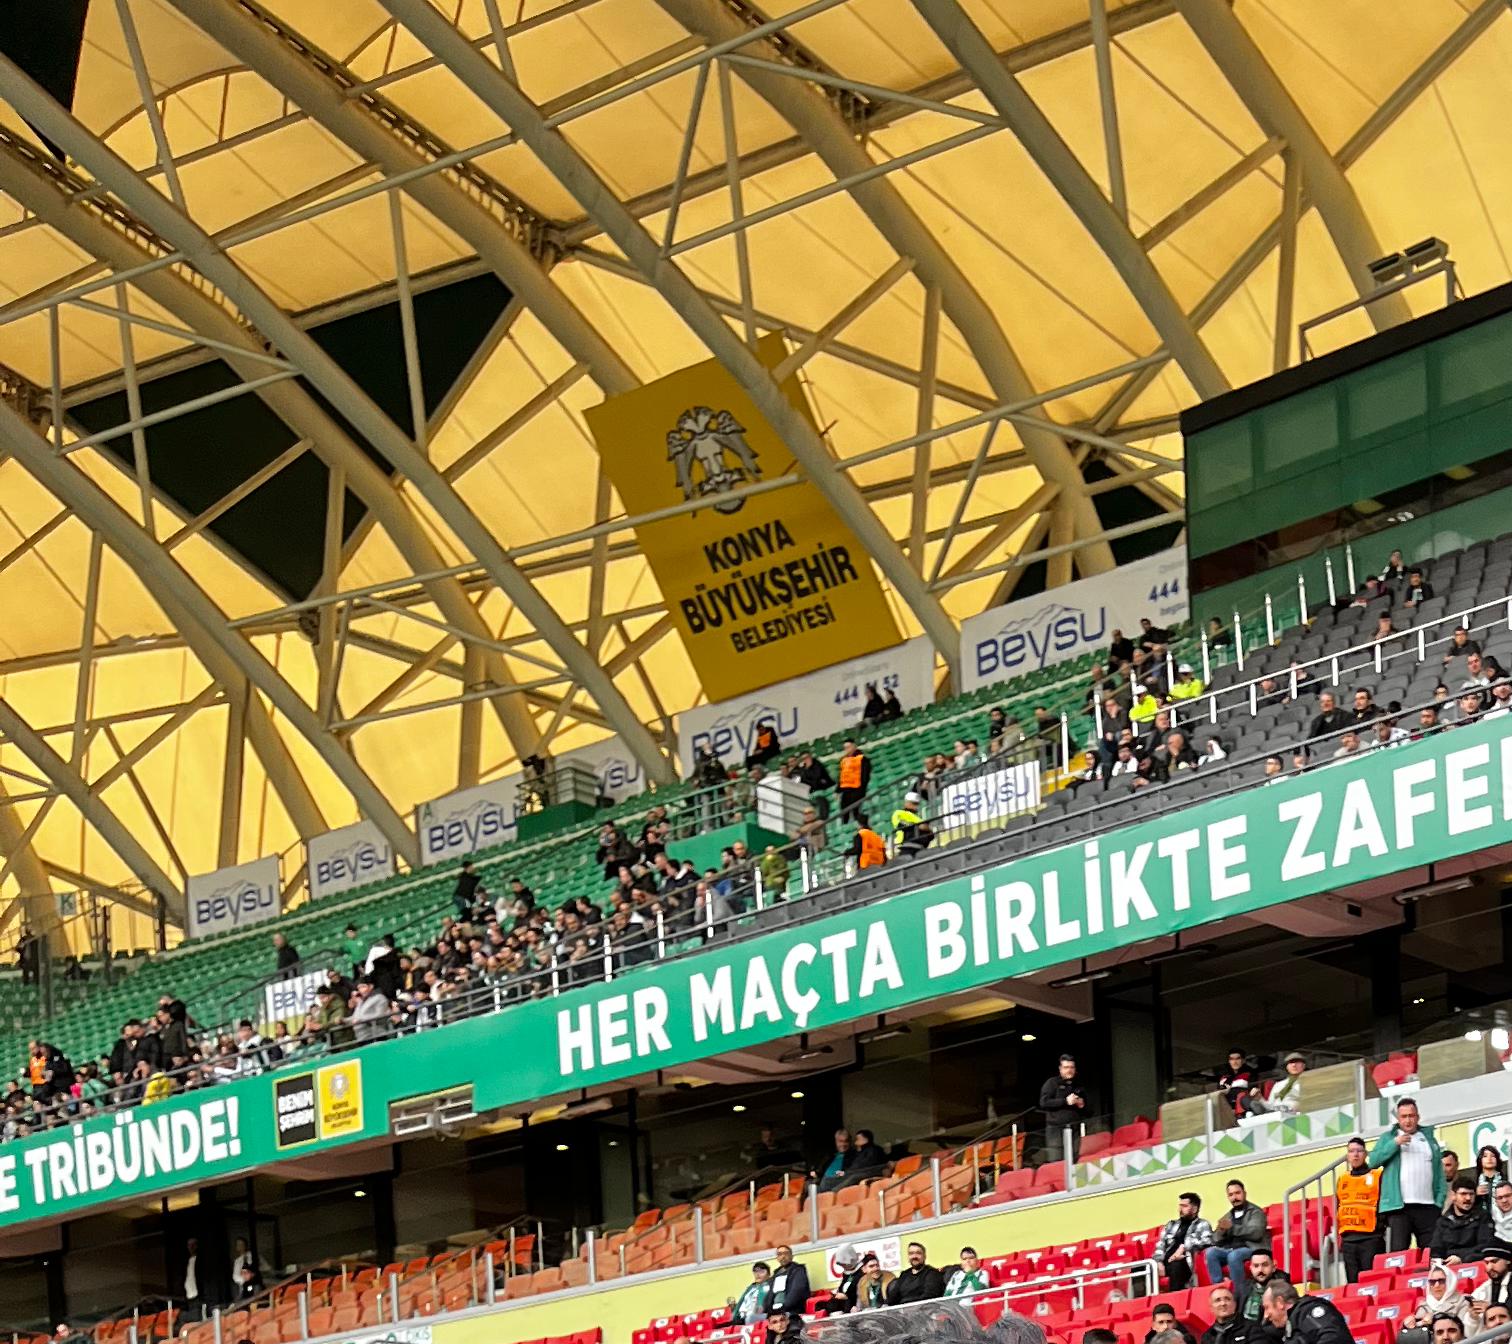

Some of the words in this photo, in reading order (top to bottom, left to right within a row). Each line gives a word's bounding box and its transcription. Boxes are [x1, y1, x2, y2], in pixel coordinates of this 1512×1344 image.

[704, 519, 796, 573] KONYA
[680, 543, 858, 634] BÜYÜKŞEHİR
[1148, 578, 1180, 602] 444
[730, 596, 837, 652] BELEDİYESİ
[834, 686, 858, 704] 444
[558, 978, 672, 1075] HER
[692, 920, 903, 1042] MAÇTA
[925, 815, 1250, 980] BİRLİKTE
[24, 1096, 242, 1204] TRİBÜNDE!
